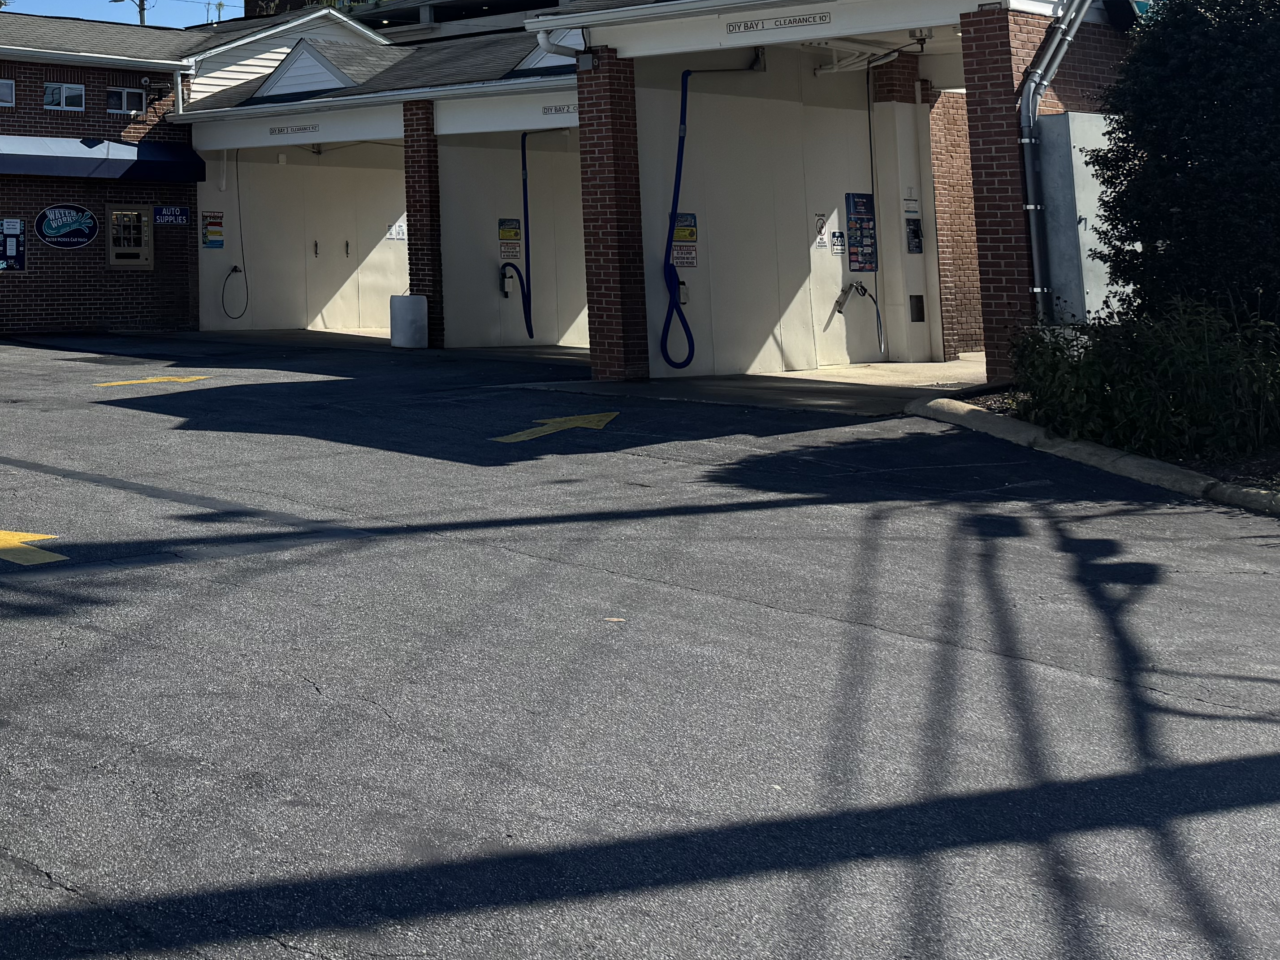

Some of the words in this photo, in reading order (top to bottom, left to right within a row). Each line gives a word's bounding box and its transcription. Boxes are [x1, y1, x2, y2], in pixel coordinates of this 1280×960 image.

[728, 24, 742, 32] DIY
[743, 22, 760, 31] BAY
[761, 21, 765, 29] 1
[774, 16, 817, 27] CLEARANCE
[45, 208, 78, 221] WATER
[162, 207, 180, 215] AUTO
[50, 216, 78, 229] WORKS
[155, 215, 187, 223] SUPPLIES
